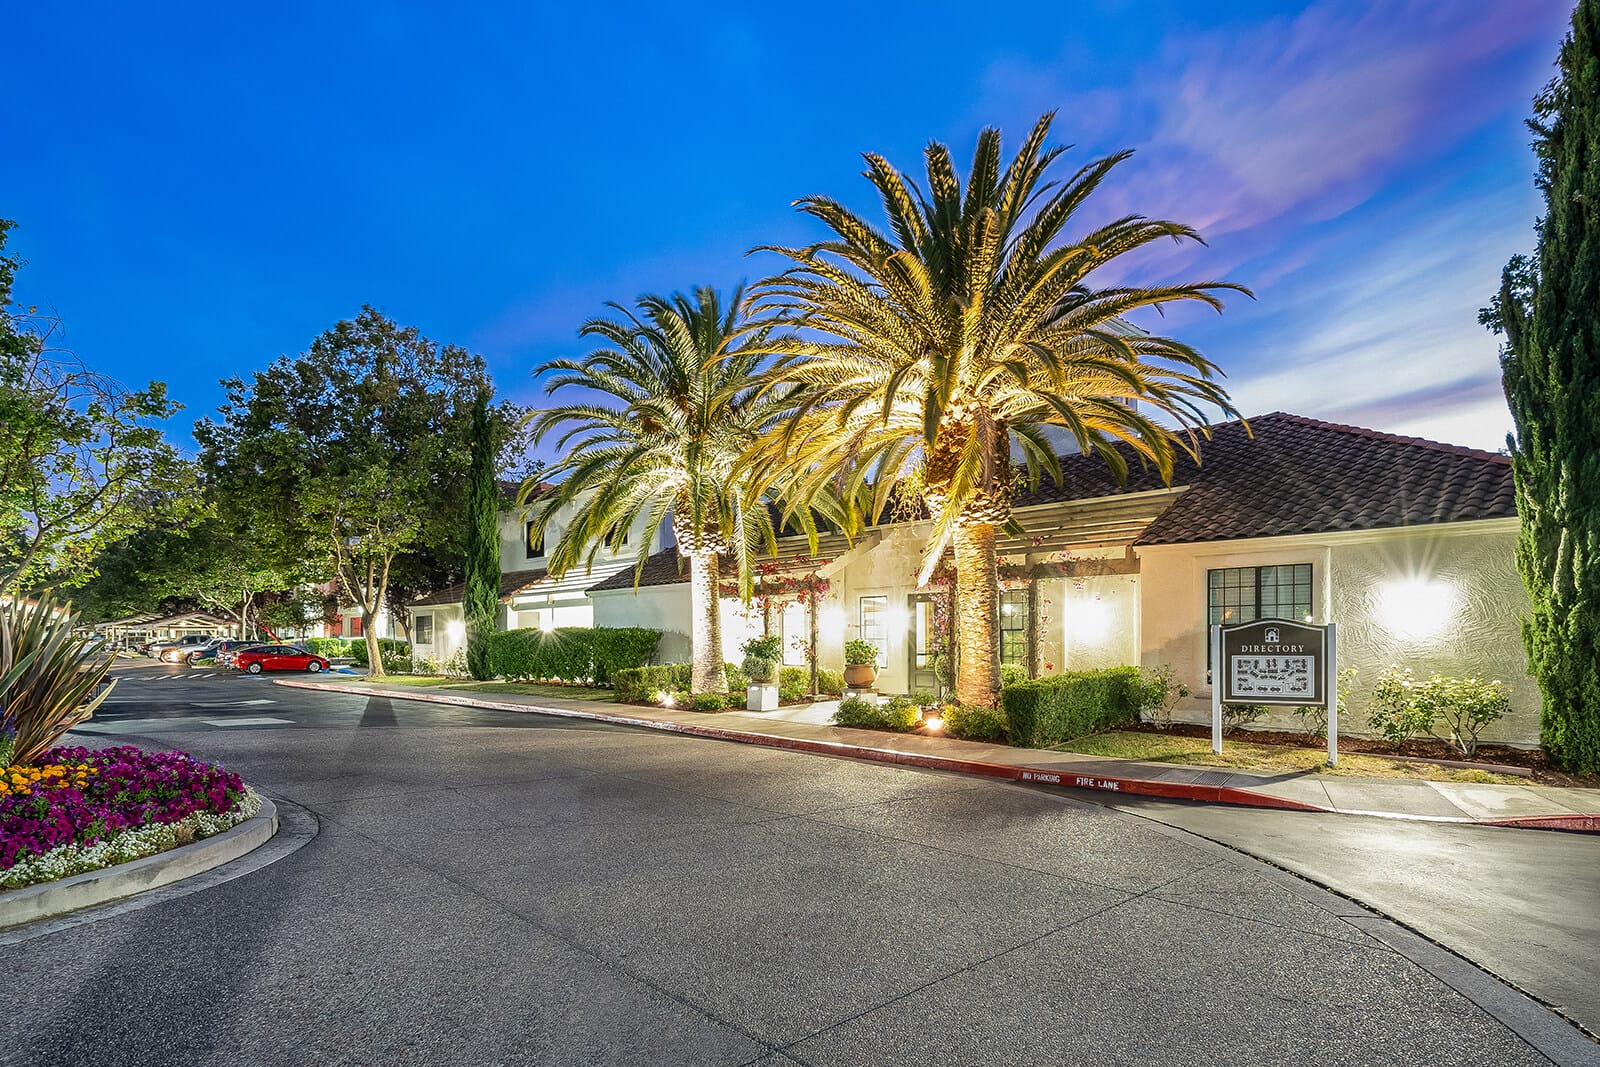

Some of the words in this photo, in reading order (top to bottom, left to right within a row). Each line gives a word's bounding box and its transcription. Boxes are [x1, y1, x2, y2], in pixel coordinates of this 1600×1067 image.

[1241, 644, 1304, 652] DIRECTORY
[1022, 772, 1032, 780] NO
[1033, 773, 1060, 783] PARKING
[1076, 777, 1094, 786] FIRE
[1098, 780, 1119, 791] LANE
